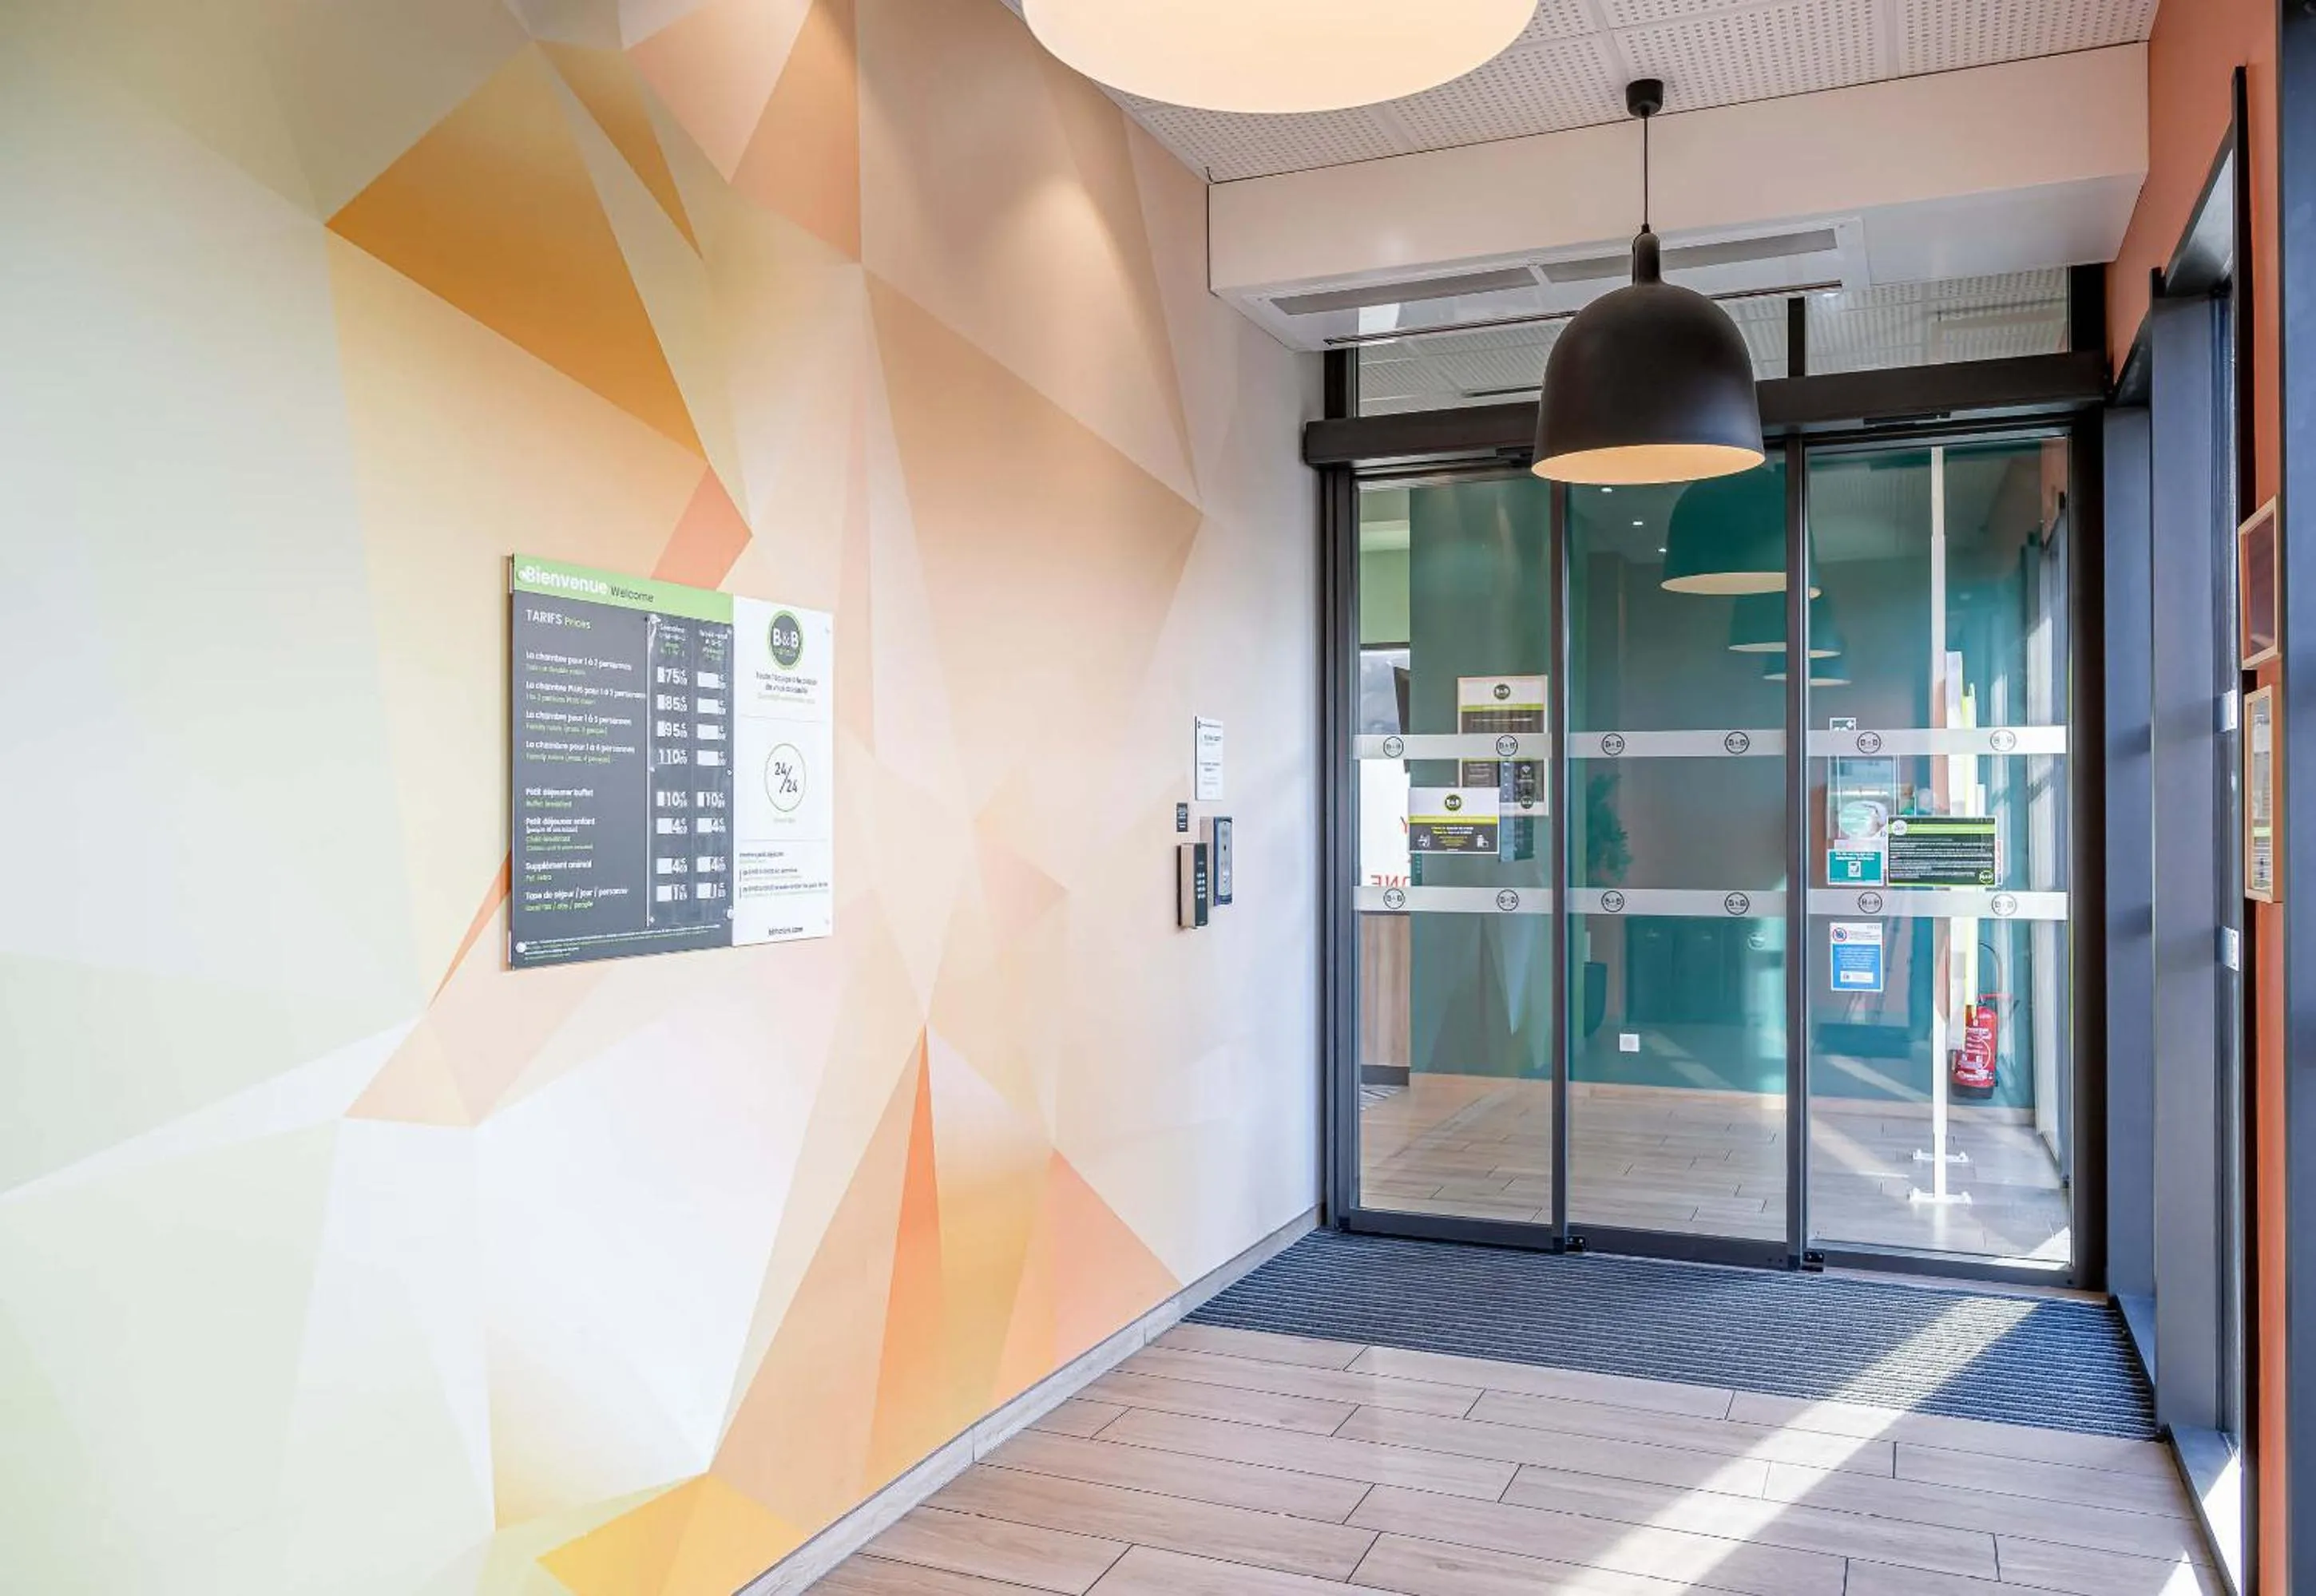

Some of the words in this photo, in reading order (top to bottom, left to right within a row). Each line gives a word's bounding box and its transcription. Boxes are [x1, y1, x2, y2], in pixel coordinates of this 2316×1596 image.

[526, 565, 609, 594] Bienvenue
[610, 586, 655, 602] Welcome
[525, 609, 563, 625] TARIFS
[564, 616, 592, 629] Prices
[773, 628, 799, 648] B&B
